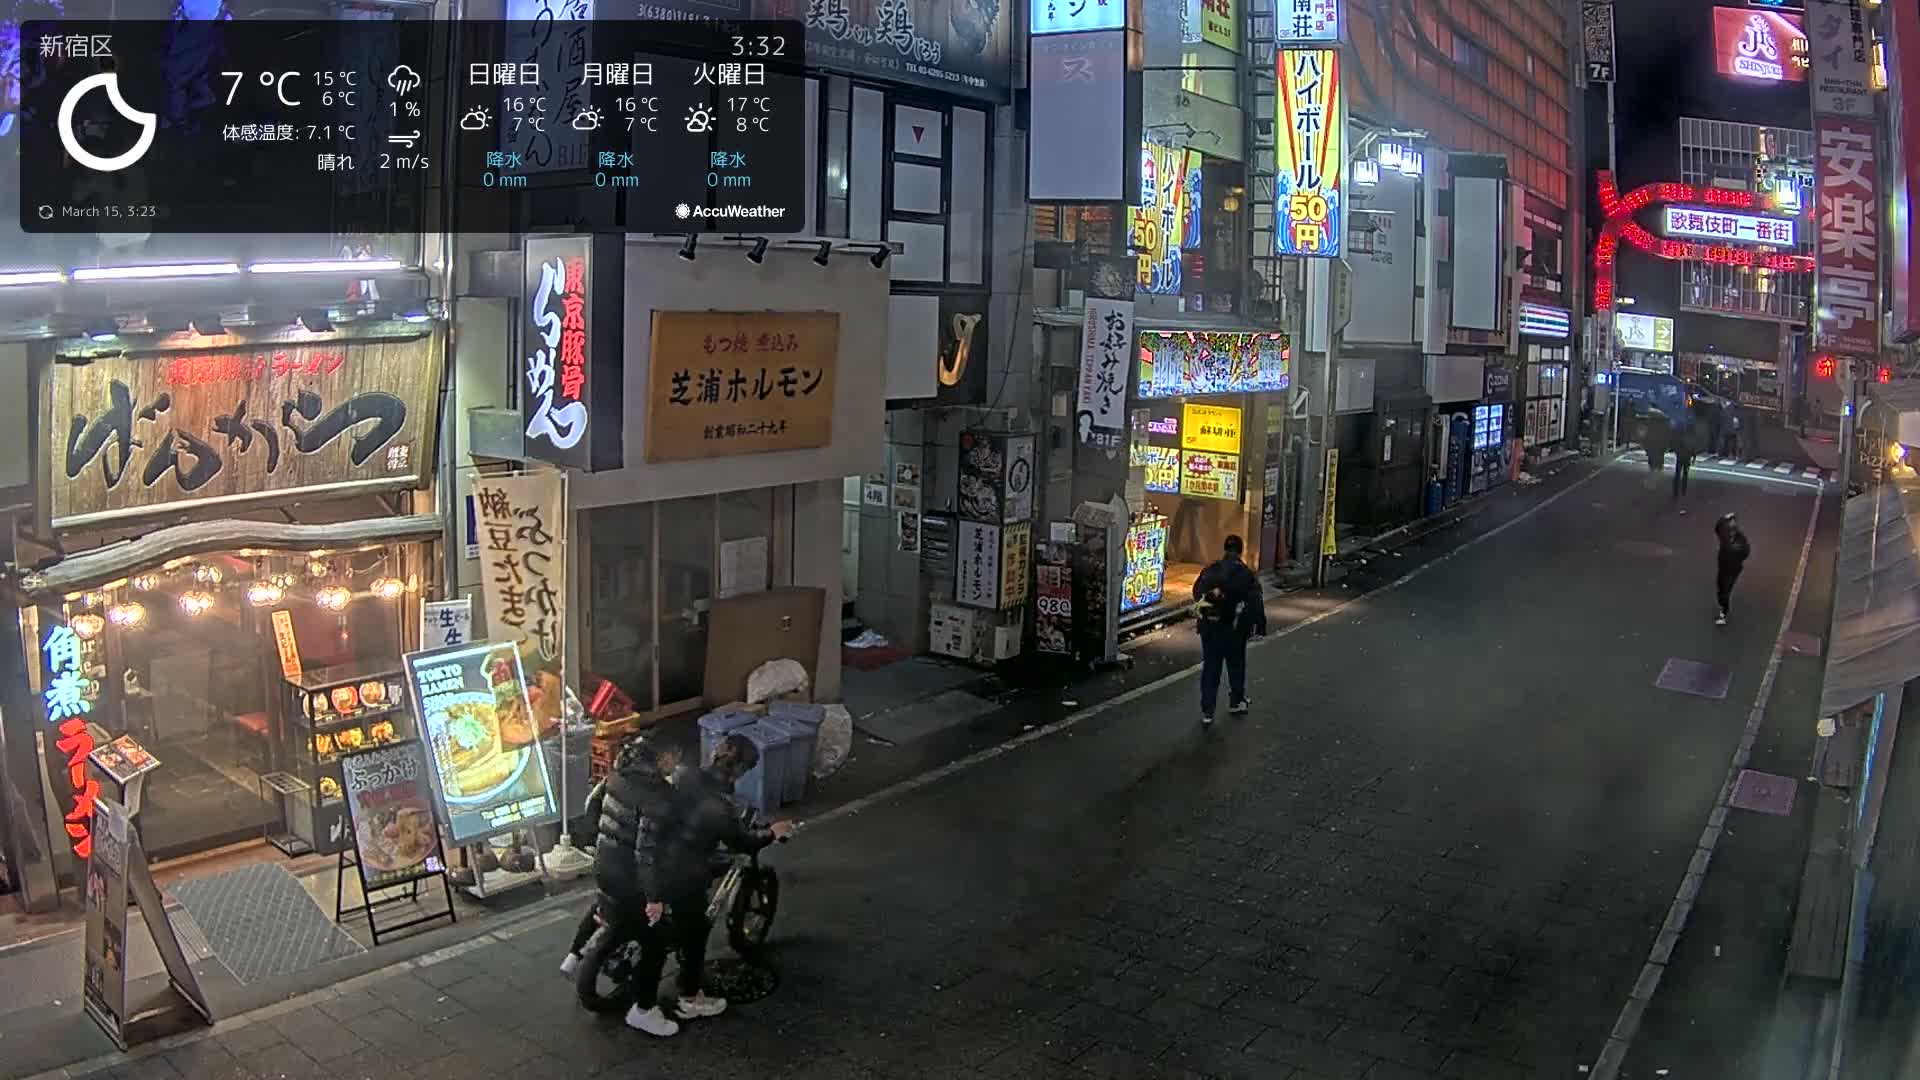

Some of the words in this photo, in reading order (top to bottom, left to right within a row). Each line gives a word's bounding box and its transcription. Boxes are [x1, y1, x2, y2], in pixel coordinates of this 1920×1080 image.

[1588, 63, 1610, 80] 7F
[1296, 54, 1322, 192] ハイボール
[1161, 152, 1176, 288] ハイボール
[1670, 211, 1790, 243] 歌舞伎町一番街
[1820, 127, 1876, 331] 安楽亭
[561, 256, 586, 400] 東京豚骨
[703, 333, 748, 353] もつ焼
[1819, 334, 1837, 347] 2F
[1096, 309, 1126, 415] お好み焼き
[669, 367, 823, 406] 芝浦ホルモン
[703, 420, 789, 440] 創業昭和二十九年
[43, 625, 91, 722] 角煮
[417, 664, 463, 683] TOKYO
[352, 757, 421, 790] ぶっかけ
